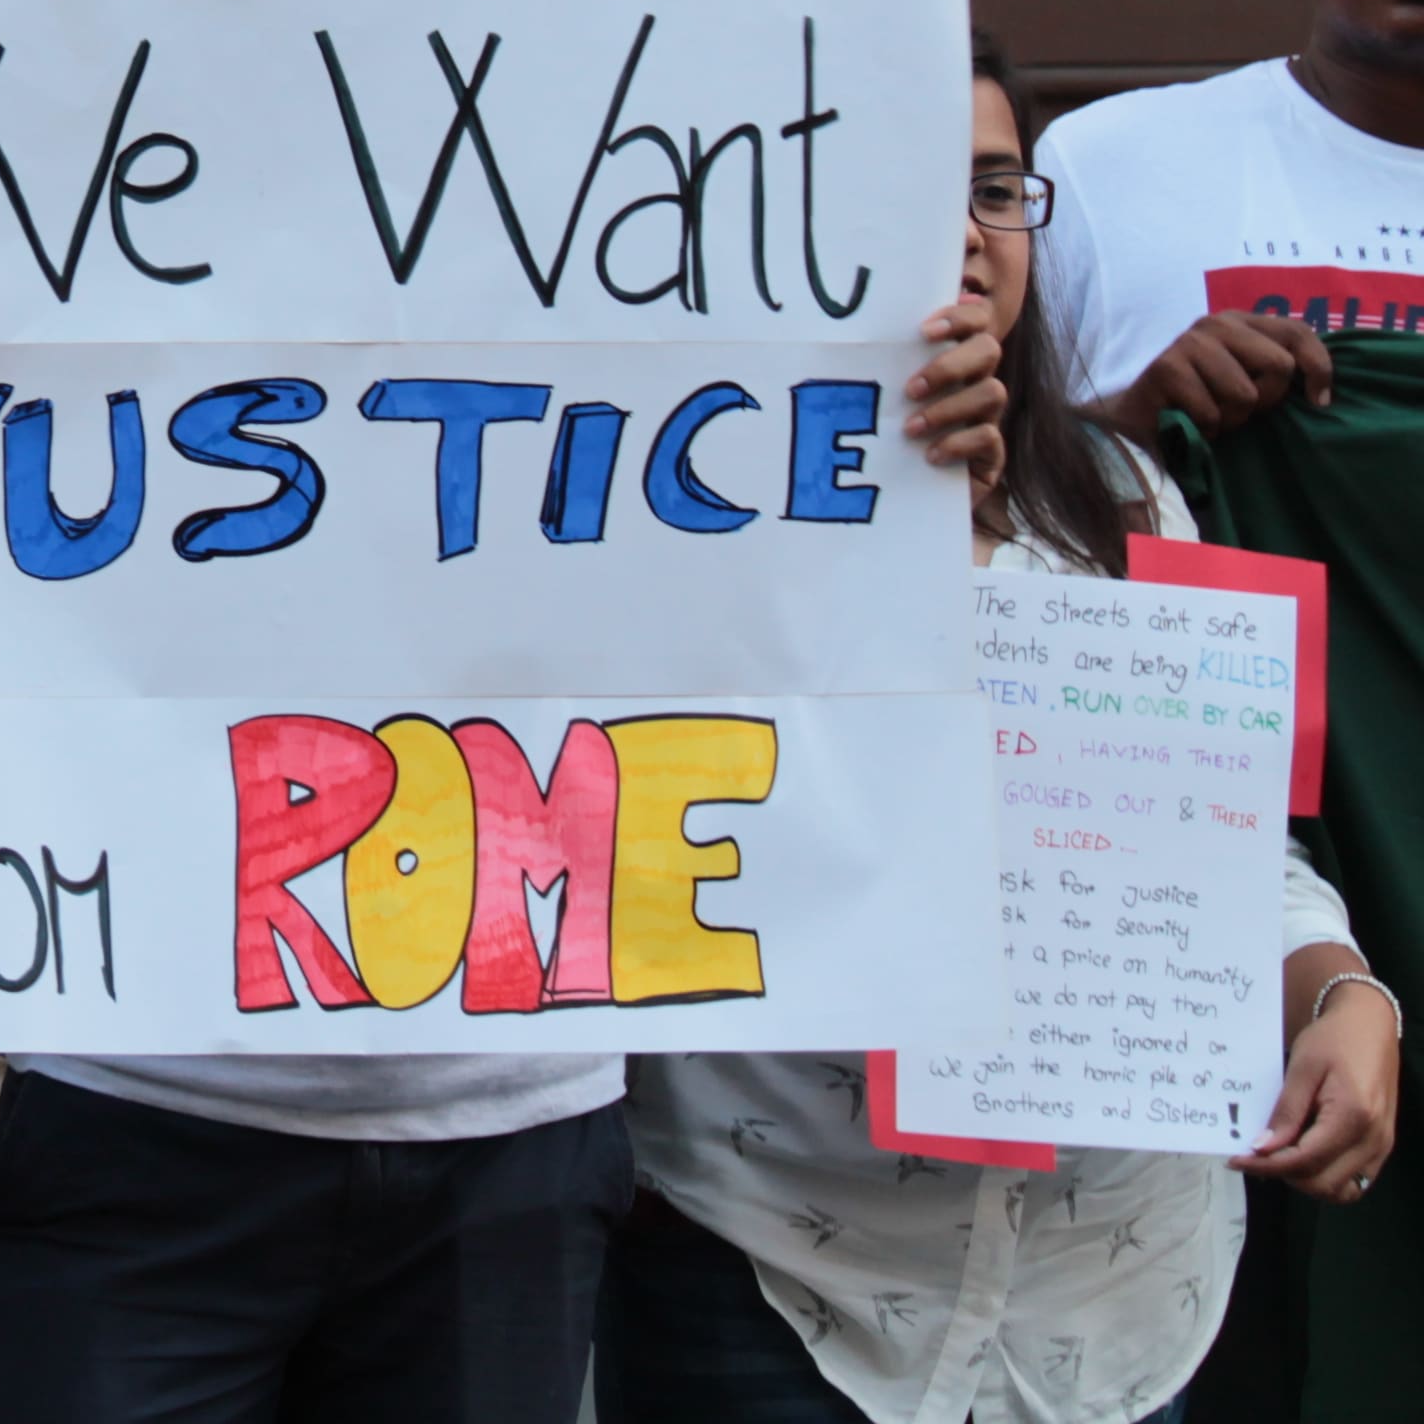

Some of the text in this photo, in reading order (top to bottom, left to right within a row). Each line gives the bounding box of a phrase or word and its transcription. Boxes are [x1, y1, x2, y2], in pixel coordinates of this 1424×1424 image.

[313, 14, 871, 319] Want
[1243, 240, 1301, 258] LOS
[973, 586, 1017, 620] The
[1204, 612, 1257, 641] safe
[976, 629, 1049, 666] dents
[1074, 651, 1113, 674] are
[1130, 649, 1188, 693] being
[1061, 686, 1122, 714] RUN
[1133, 694, 1190, 721] OVER
[1202, 703, 1230, 727] BY
[1238, 707, 1283, 734] CAR
[1079, 739, 1171, 766] HAVING
[1187, 748, 1252, 772] THEIR
[1002, 780, 1092, 810] GOUGED
[1114, 793, 1157, 816] OUT
[1207, 803, 1258, 831] THEIR
[227, 713, 778, 1014] ROME
[1058, 870, 1096, 896] for
[1060, 909, 1092, 930] for
[1061, 948, 1112, 971] price
[1122, 957, 1148, 975] on
[1164, 959, 1255, 1003] humanity
[1054, 983, 1078, 1006] do
[1087, 990, 1117, 1009] not
[1125, 993, 1156, 1021] pay
[1171, 994, 1218, 1019] then
[1028, 1023, 1092, 1047] either
[1112, 1027, 1189, 1057] ignored
[972, 1052, 1016, 1084] join
[1029, 1055, 1062, 1077] the
[1191, 1070, 1213, 1089] of
[1220, 1078, 1253, 1093] our
[972, 1091, 1075, 1118] Brothers
[1101, 1097, 1132, 1121] and
